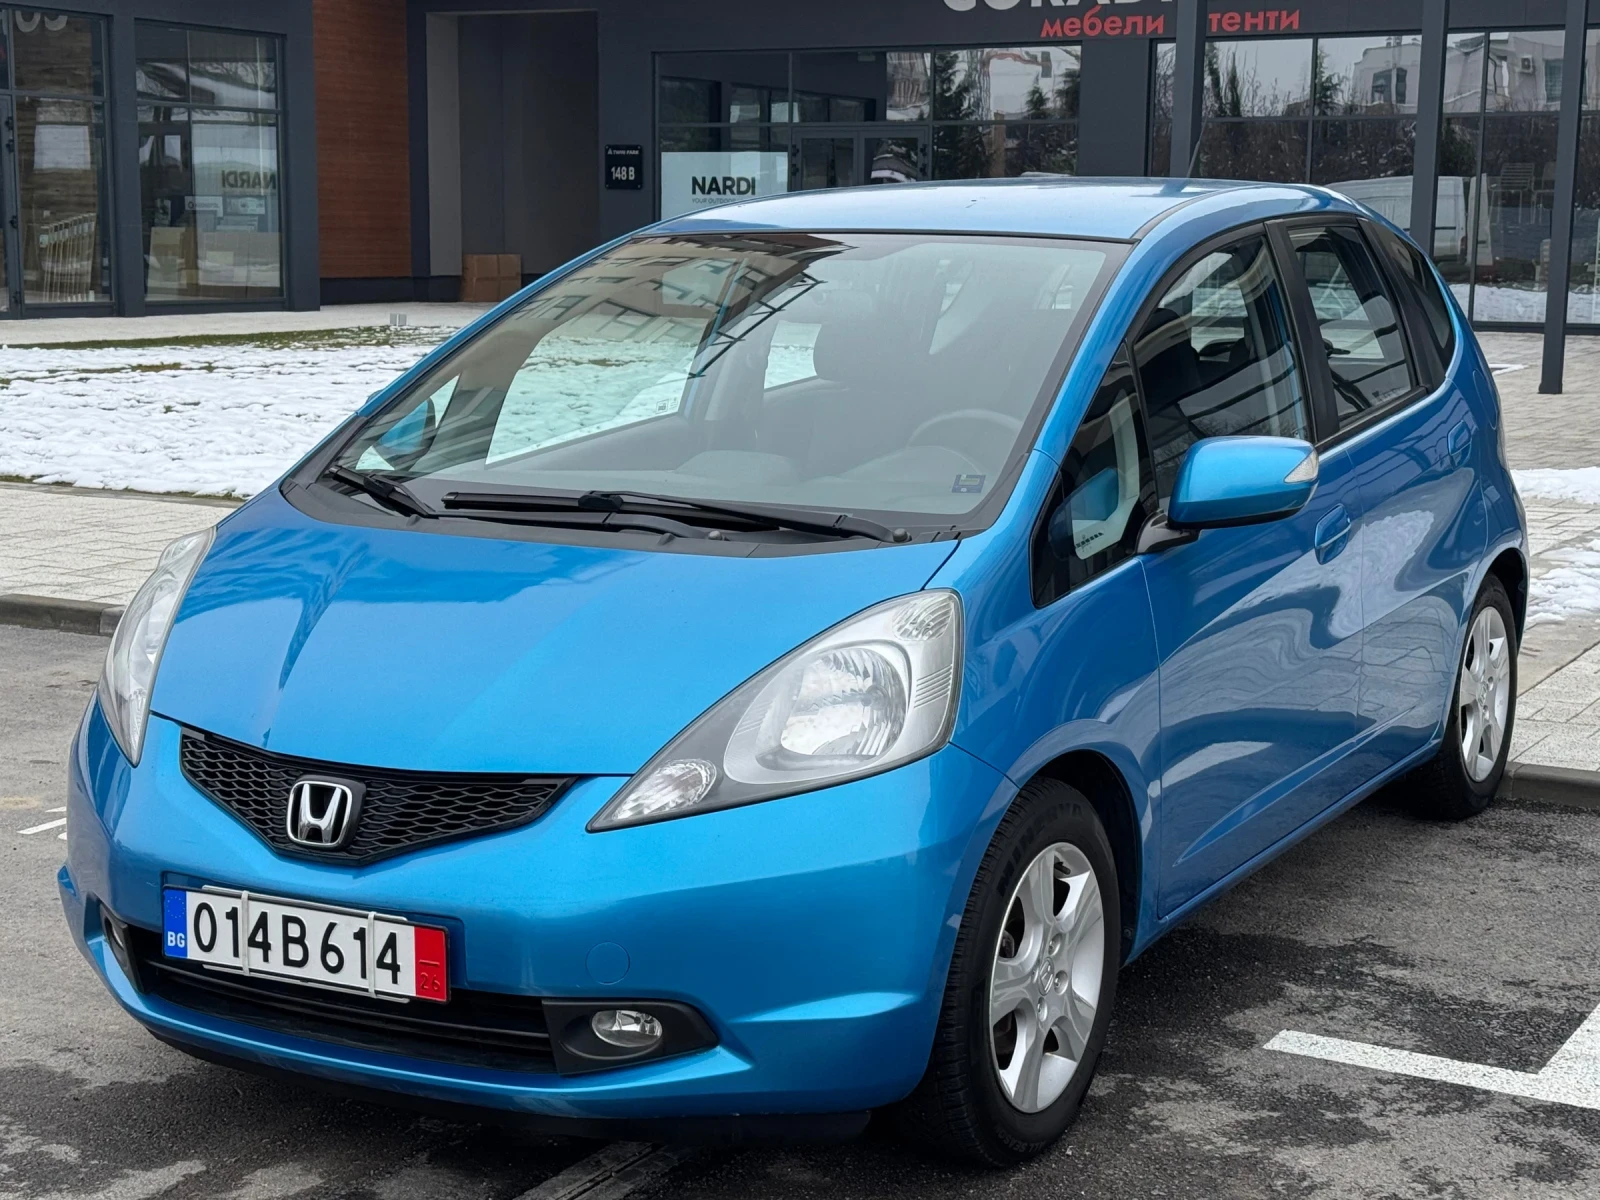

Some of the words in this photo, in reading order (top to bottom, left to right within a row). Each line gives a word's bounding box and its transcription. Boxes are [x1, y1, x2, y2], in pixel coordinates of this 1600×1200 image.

[1040, 5, 1165, 38] мебели
[1208, 9, 1300, 33] тенти
[611, 166, 627, 180] 148
[628, 166, 635, 180] B
[691, 176, 756, 196] NARDI
[167, 931, 186, 949] BG
[193, 901, 401, 985] 014B614
[419, 972, 442, 993] 26
